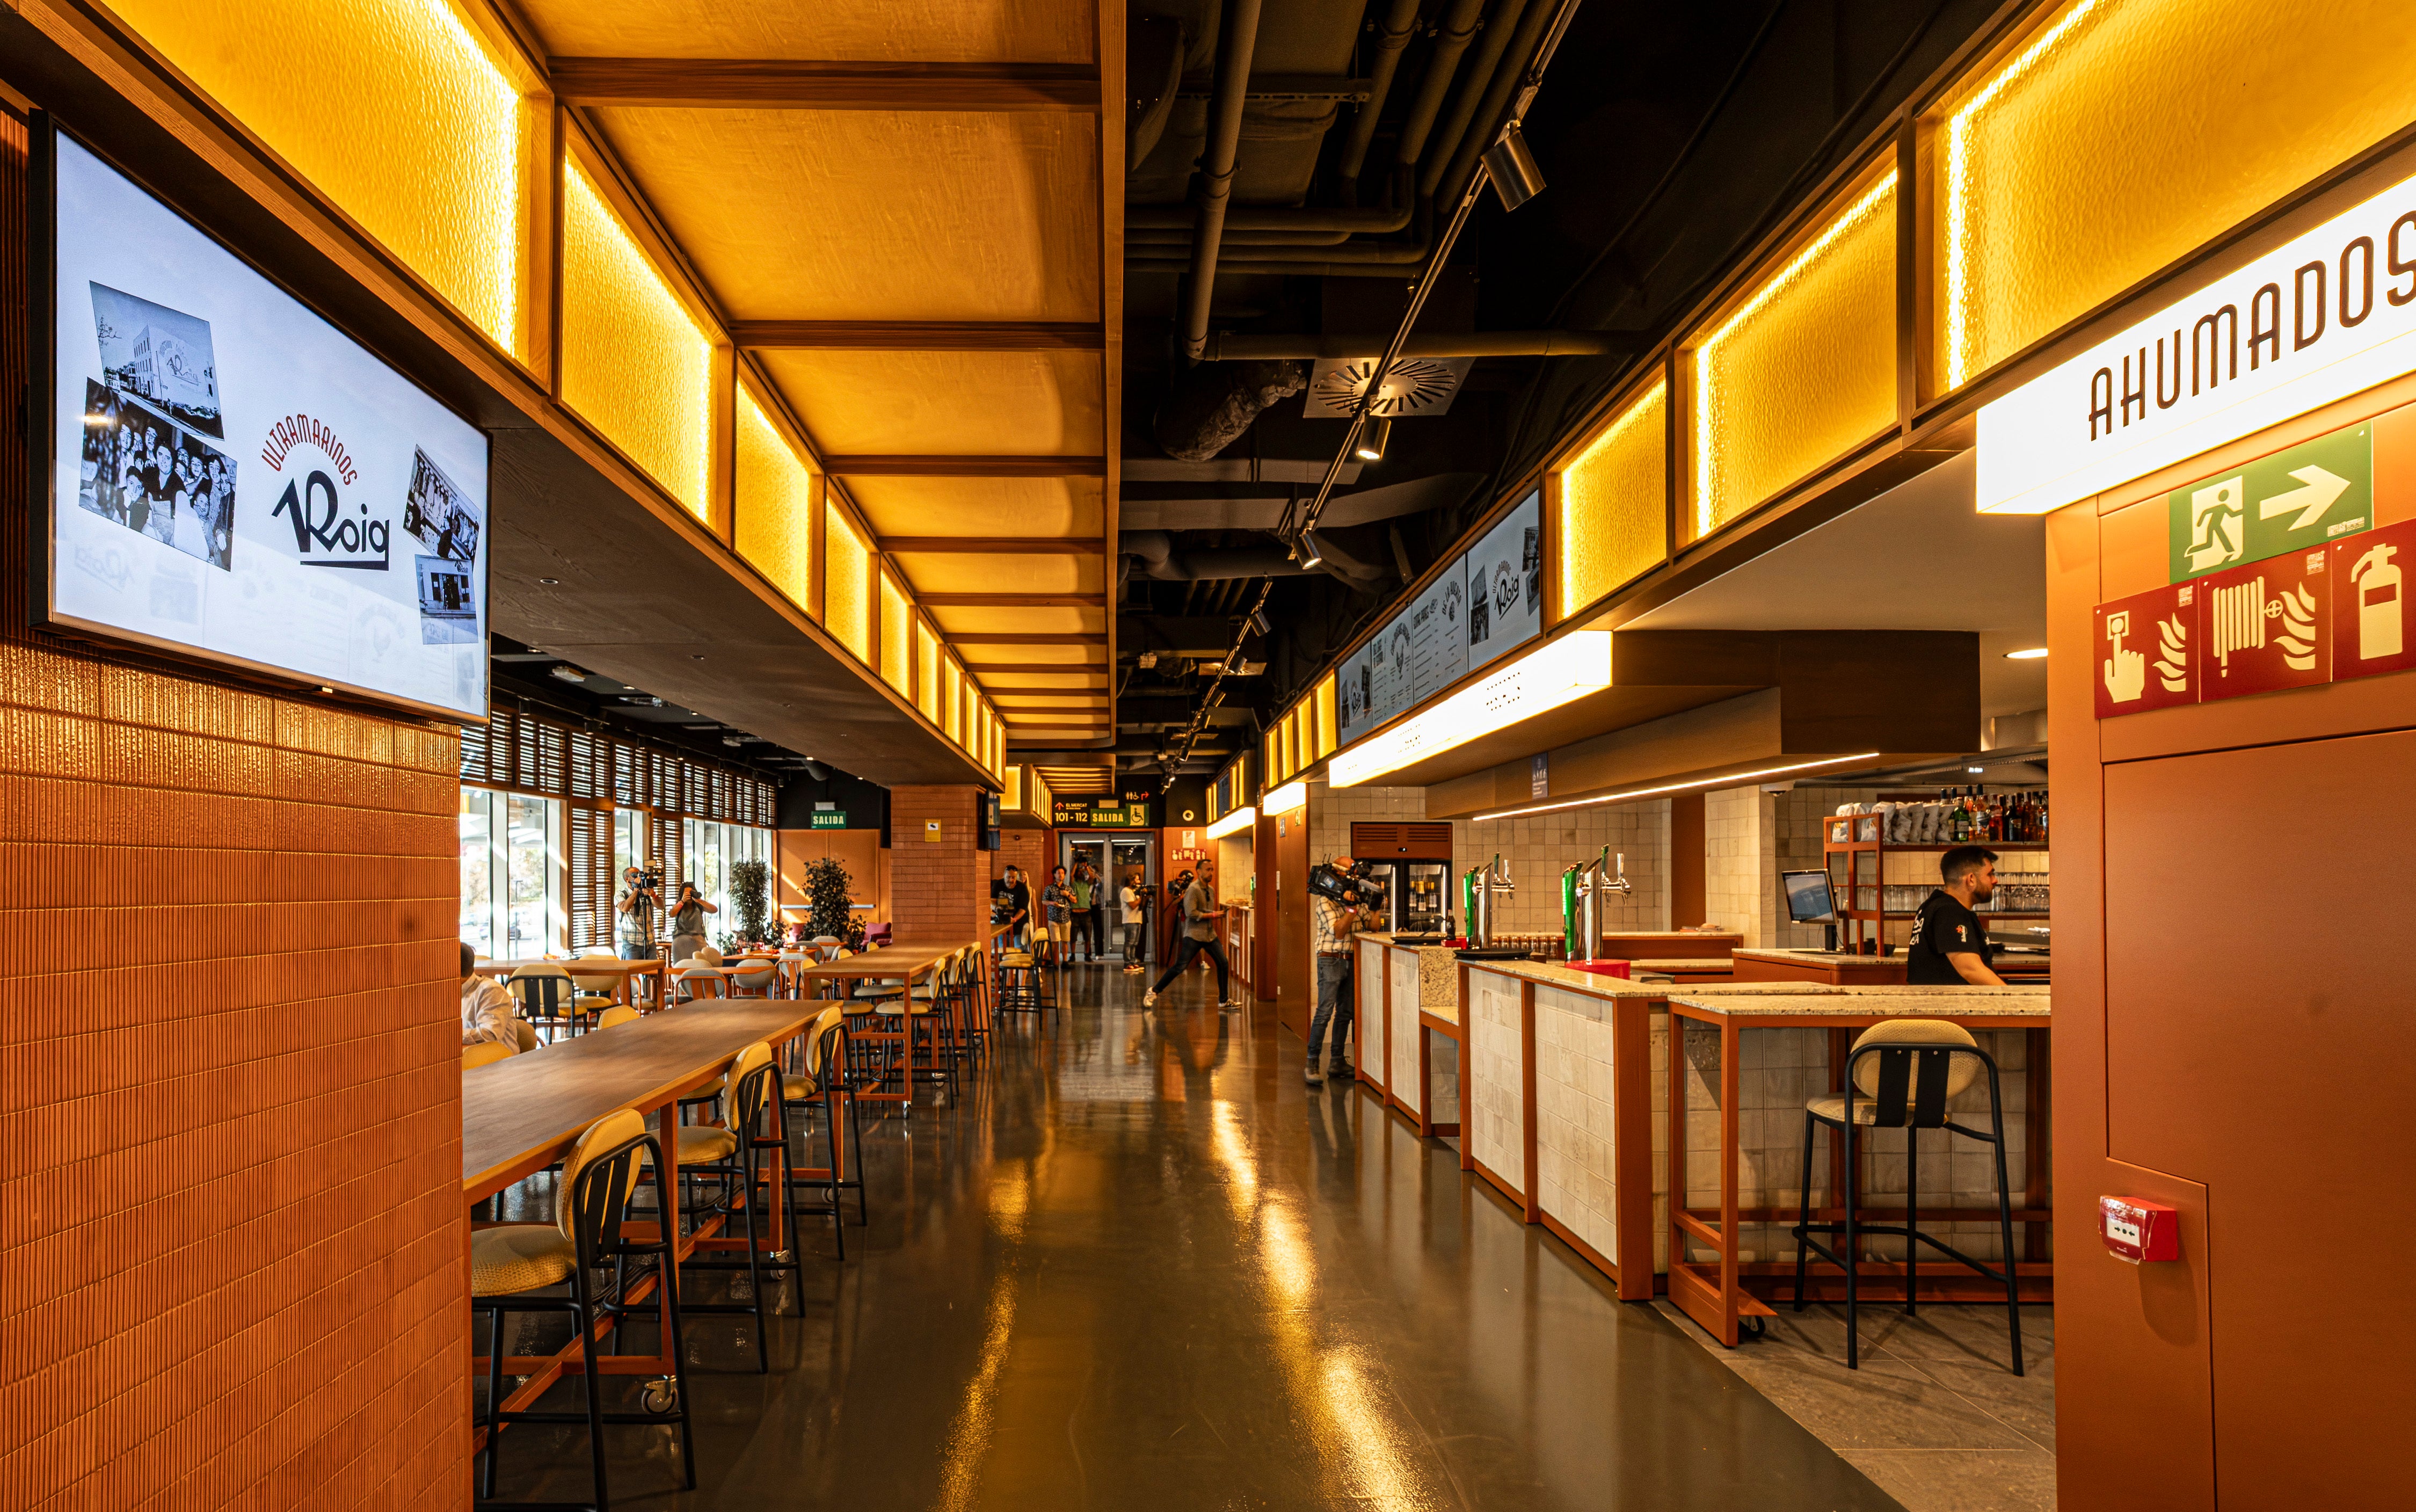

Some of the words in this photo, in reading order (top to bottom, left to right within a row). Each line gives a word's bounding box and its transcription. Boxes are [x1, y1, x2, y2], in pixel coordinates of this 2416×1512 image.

[2088, 210, 2416, 441] AHUMADOS
[261, 413, 358, 485] ULTRAMARINOS
[271, 470, 389, 571] Roig
[1494, 574, 1519, 621] Roig
[813, 816, 844, 824] SALIDA
[1055, 812, 1068, 822] 101
[1075, 812, 1088, 822] 112
[1093, 813, 1124, 822] SALIDA
